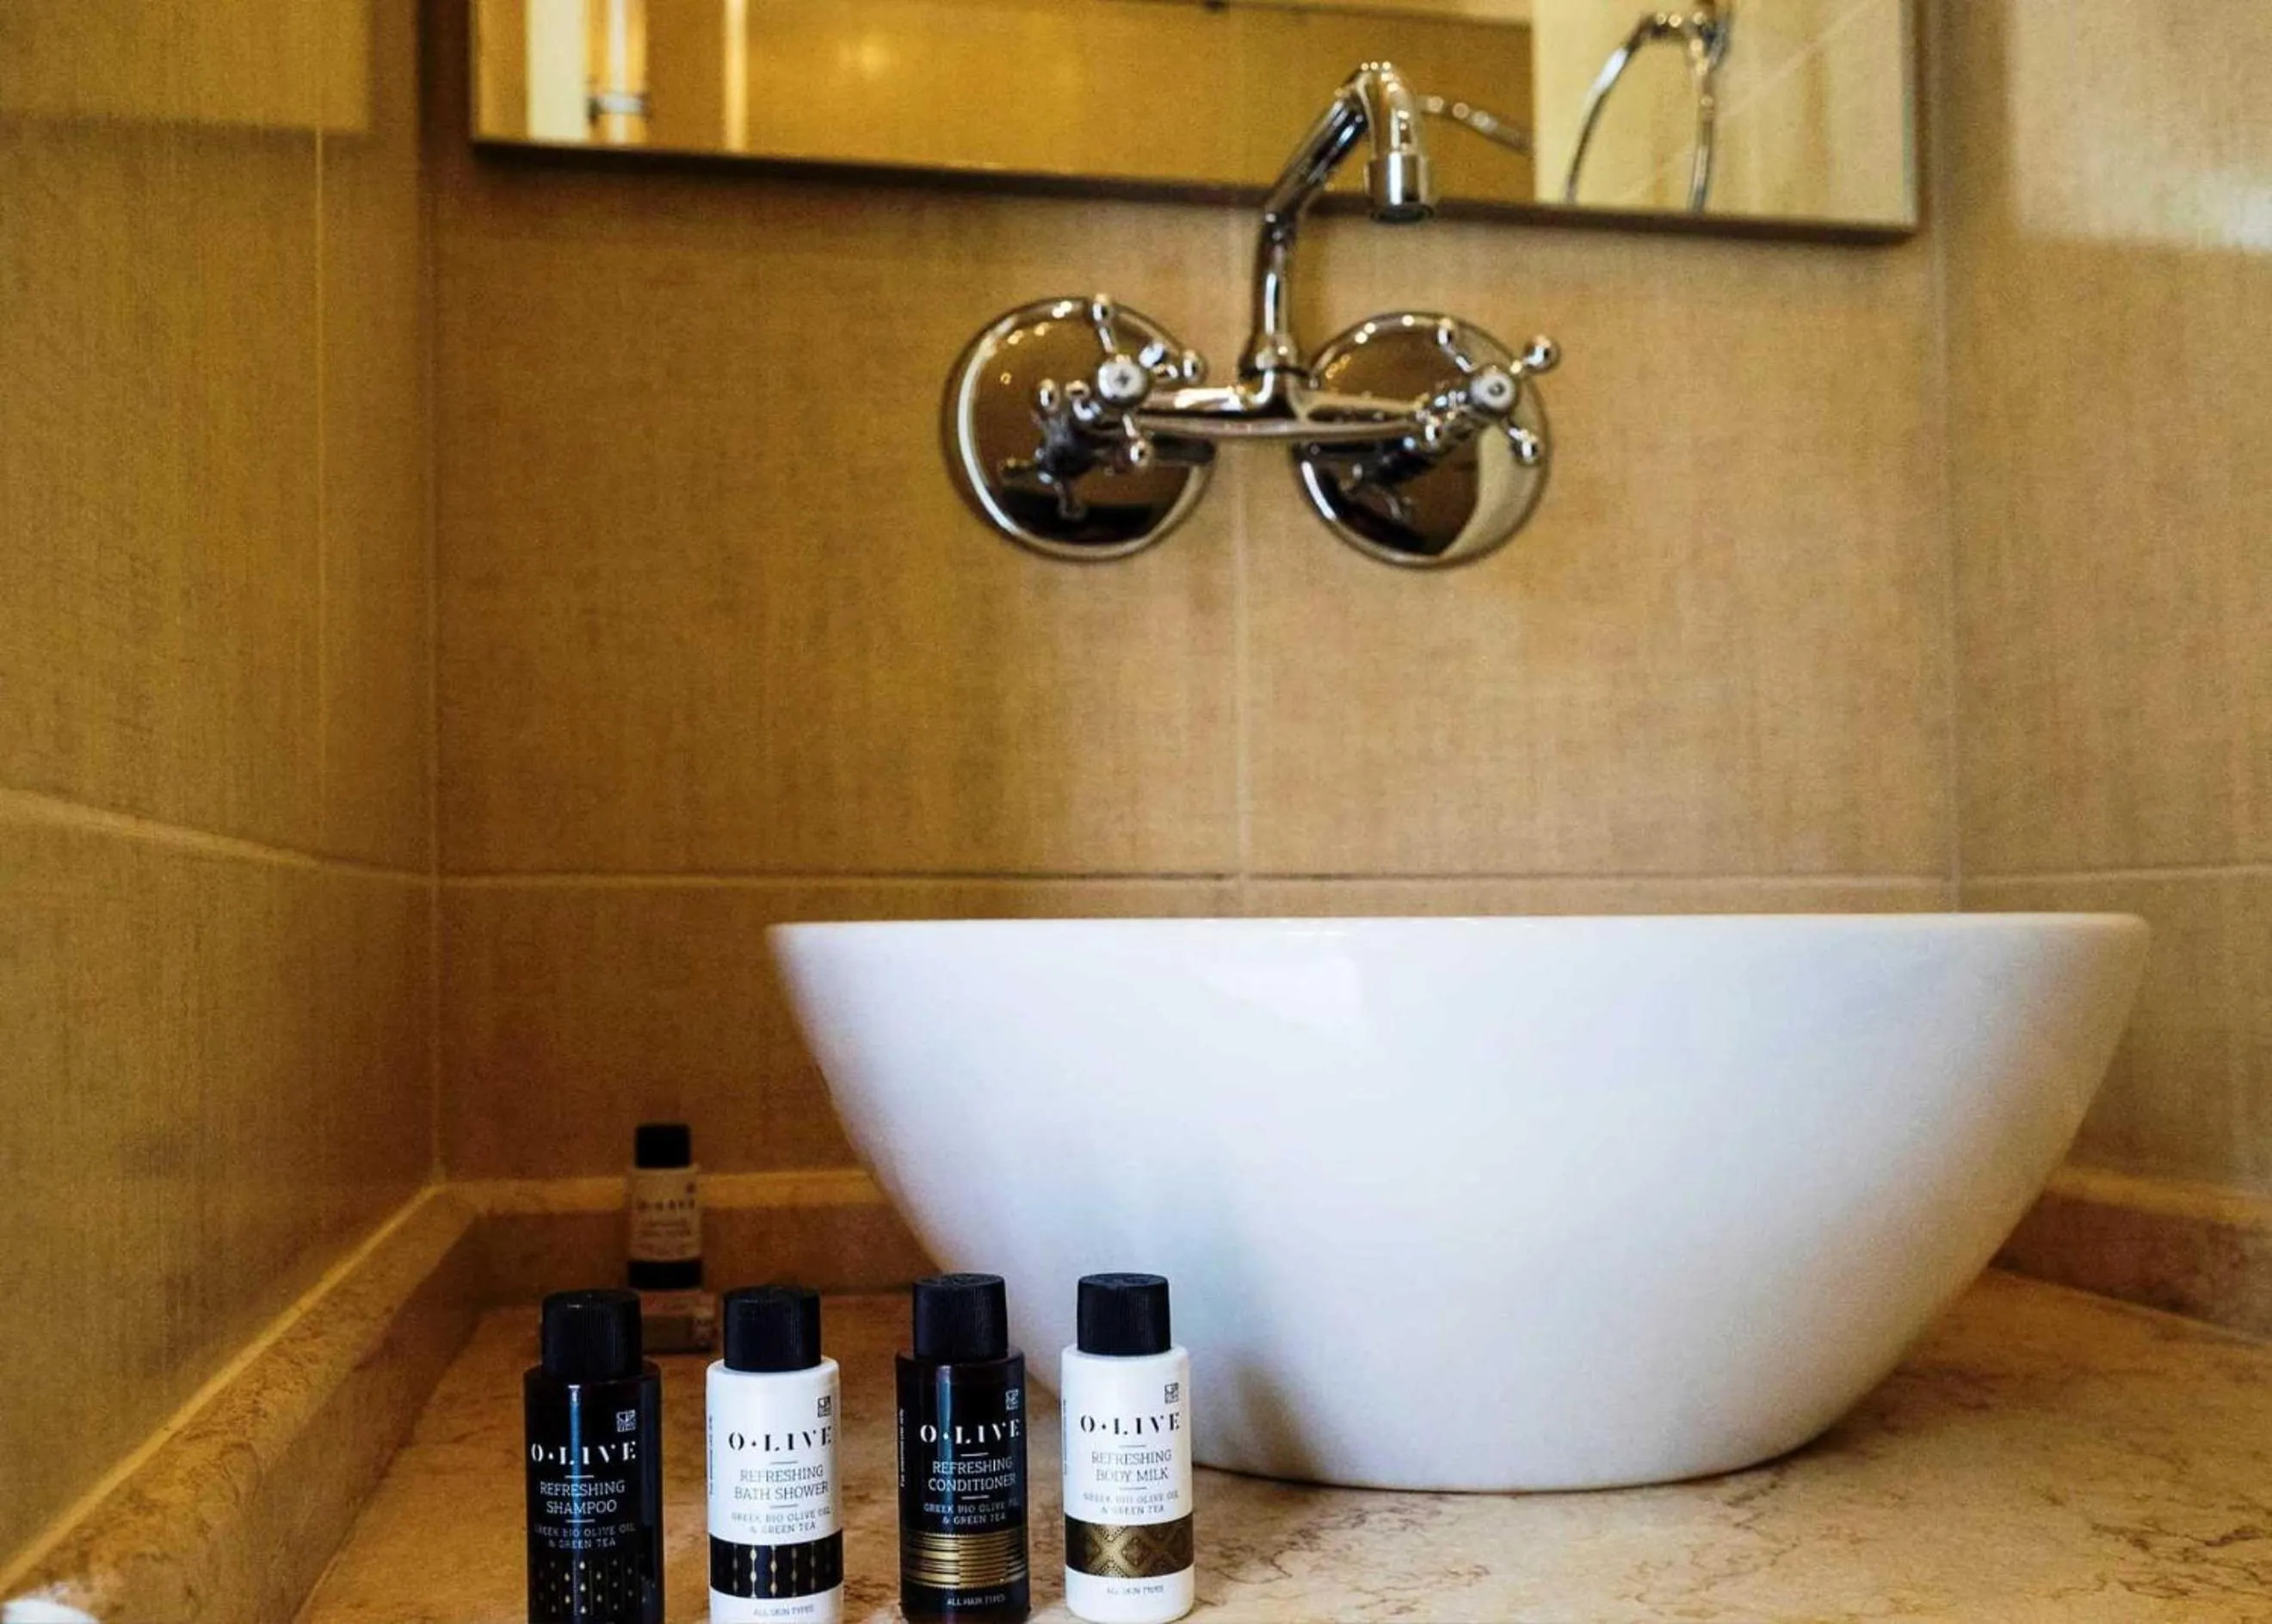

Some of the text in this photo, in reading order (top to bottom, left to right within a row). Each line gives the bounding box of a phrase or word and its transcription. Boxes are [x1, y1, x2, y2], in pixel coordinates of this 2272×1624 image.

[1090, 1448, 1172, 1466] REFRESHING
[739, 1464, 824, 1483] REFRESHING
[932, 1456, 1012, 1475] REFRESHING
[928, 1473, 1016, 1492] CONDITIONER
[1096, 1467, 1169, 1483] BODY MILK
[540, 1479, 626, 1497] REFRESHING
[734, 1480, 829, 1500] BATH SHOWER
[546, 1499, 617, 1515] SHAMPOO
[923, 1503, 954, 1515] GREEK
[958, 1504, 976, 1514] BIO
[787, 1510, 815, 1522] OLIVE
[954, 1515, 987, 1525] GREEN
[583, 1525, 617, 1537] OLIVE
[799, 1522, 816, 1531] TEA
[596, 1537, 616, 1547] TEA
